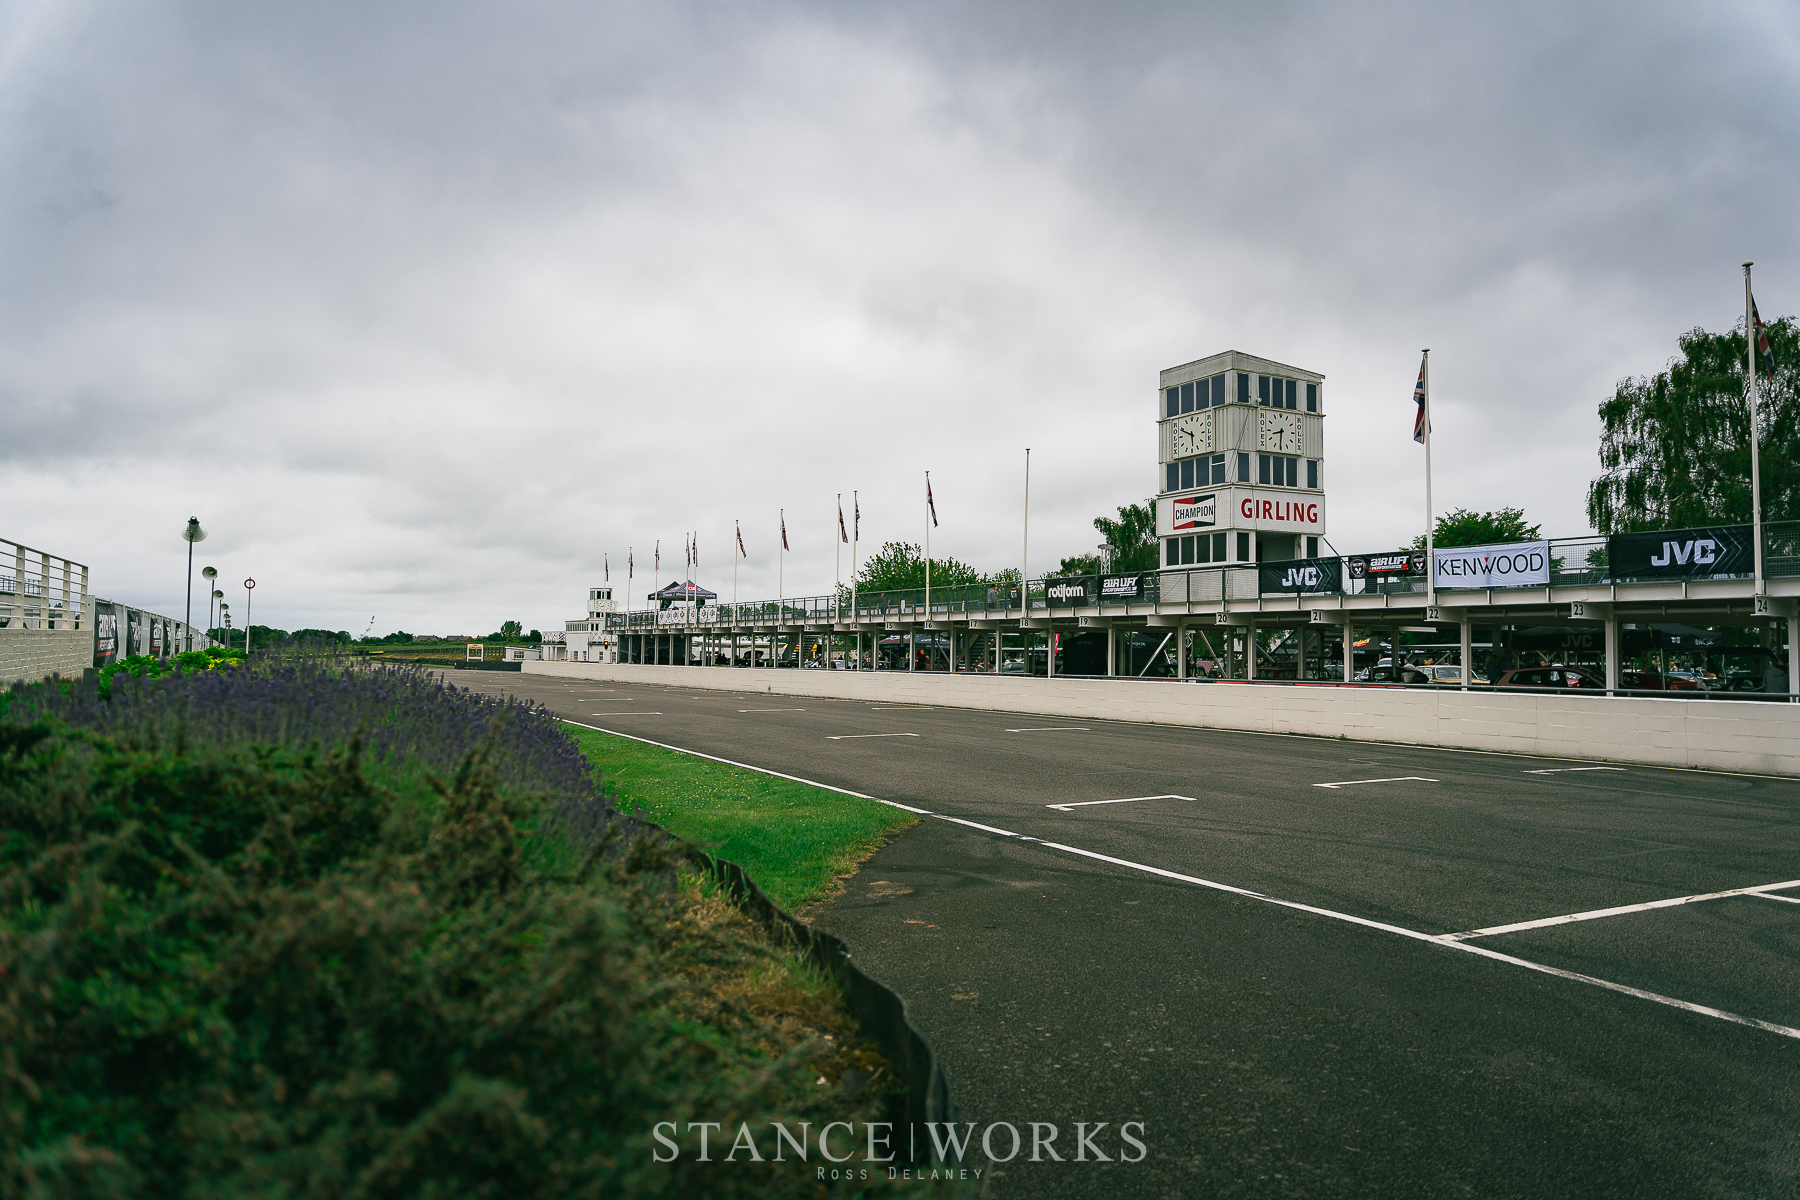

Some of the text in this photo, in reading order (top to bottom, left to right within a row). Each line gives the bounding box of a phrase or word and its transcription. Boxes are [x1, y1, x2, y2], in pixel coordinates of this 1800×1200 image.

[1175, 505, 1214, 520] CHAMPION
[1240, 498, 1318, 524] GIRLING
[1651, 539, 1716, 567] JVC
[1438, 552, 1544, 576] KENWOOD
[1282, 567, 1317, 586] JVC
[1048, 583, 1084, 602] rotiform
[1574, 604, 1584, 616] 23
[1758, 600, 1768, 612] 24
[1218, 614, 1228, 623] 20
[1313, 611, 1322, 621] 21
[1428, 608, 1439, 619] 22
[1020, 618, 1029, 626] 18
[1080, 617, 1088, 626] 19
[1561, 634, 1592, 648] JVC
